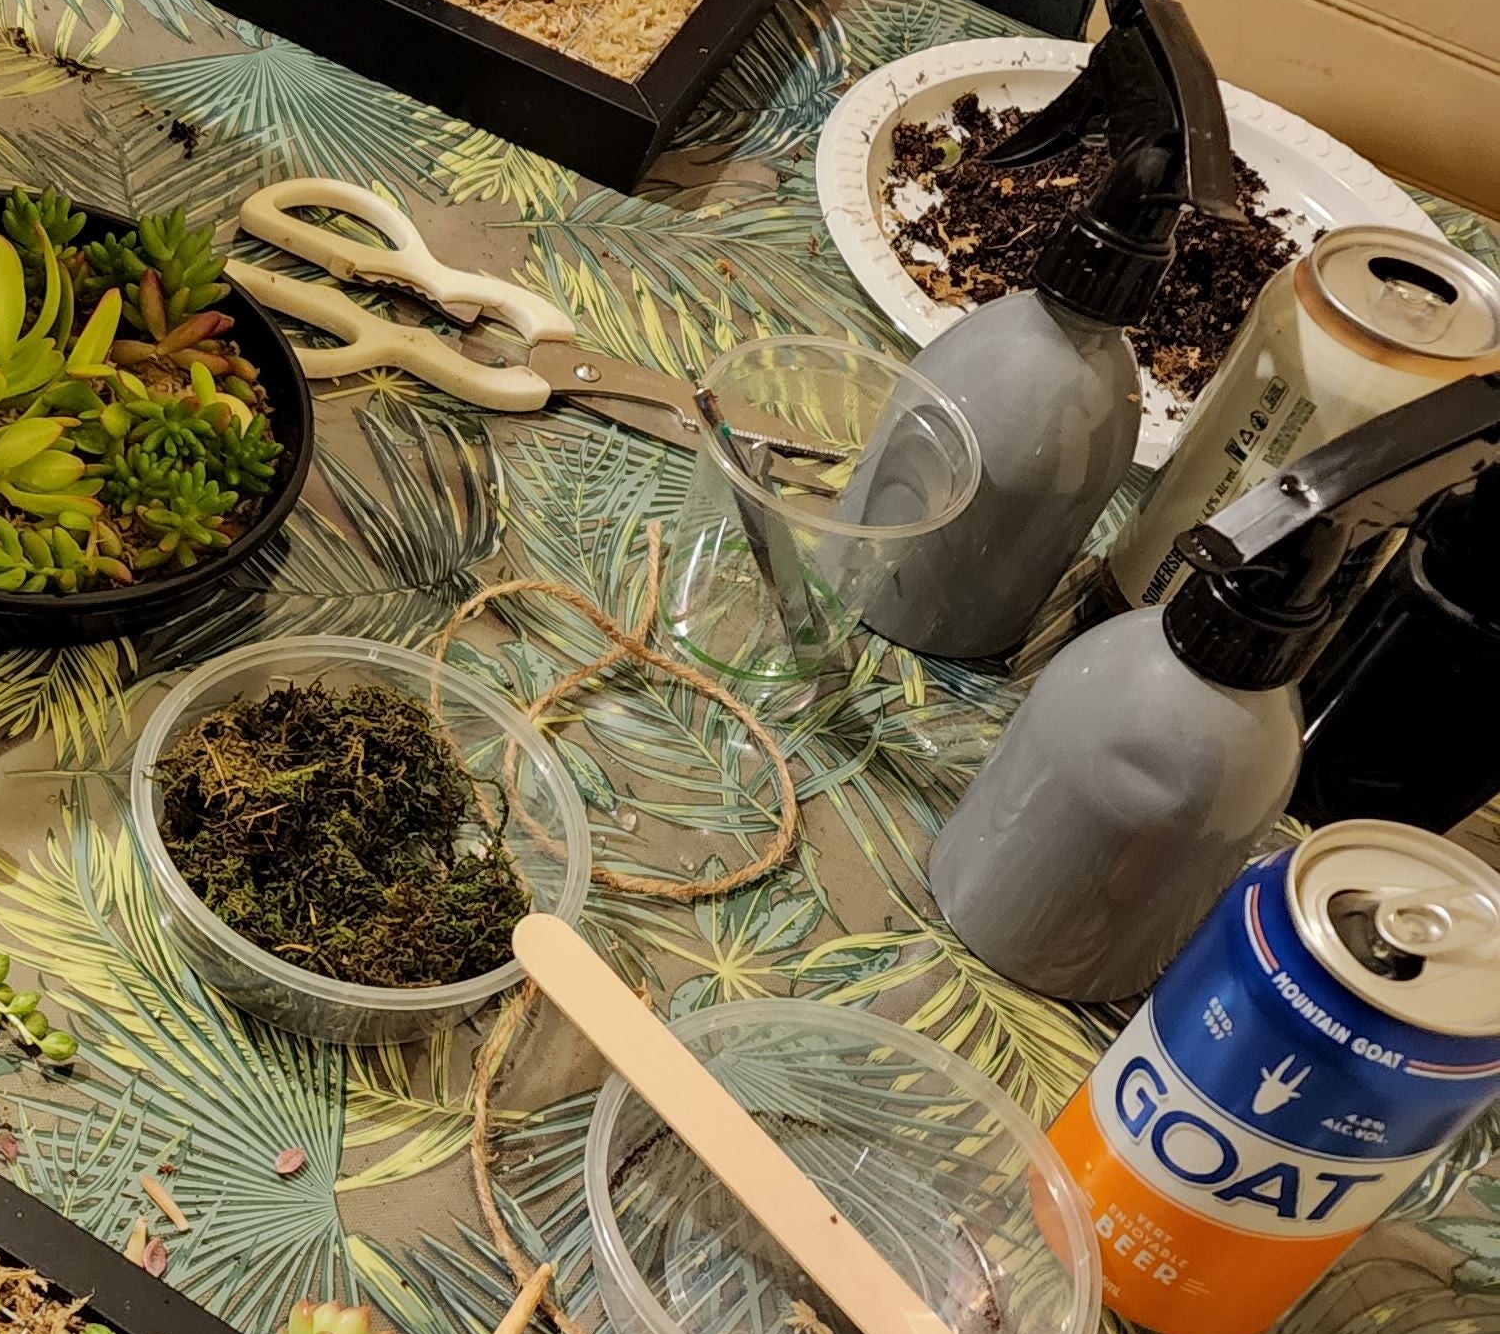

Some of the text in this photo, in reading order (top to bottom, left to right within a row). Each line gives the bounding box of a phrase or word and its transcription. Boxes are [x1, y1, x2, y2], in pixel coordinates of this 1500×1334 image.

[1141, 548, 1185, 604] SOMERSB
[1271, 970, 1405, 1069] MOUNTAIN GOAT
[1114, 1055, 1384, 1223] GOAT
[1095, 1213, 1179, 1286] BEER
[1108, 1202, 1189, 1269] ENJOYABLE
[1136, 1212, 1173, 1244] VERY
